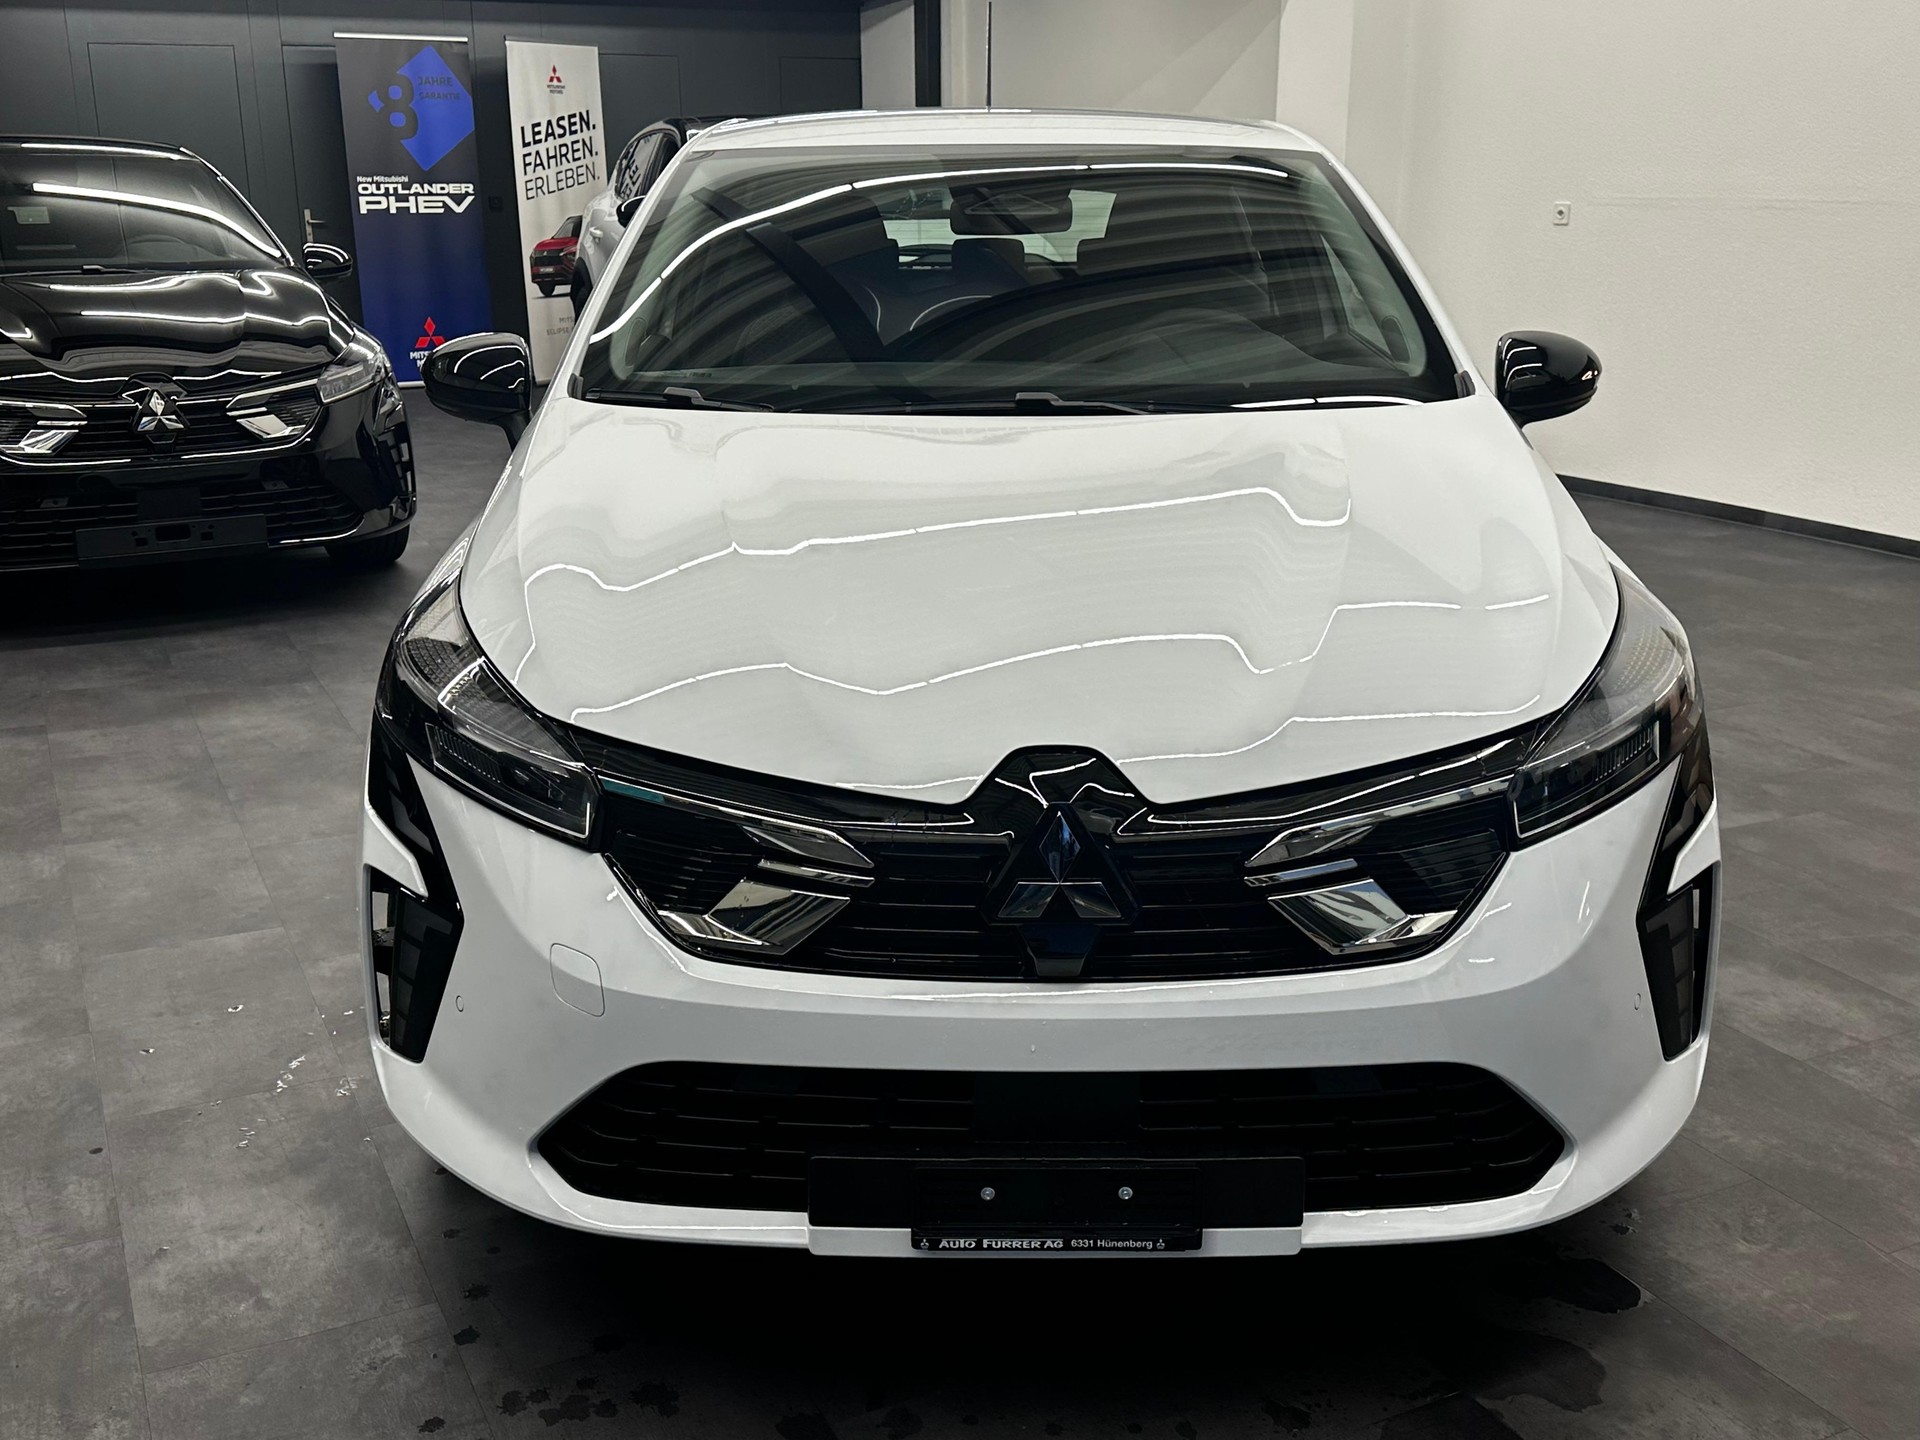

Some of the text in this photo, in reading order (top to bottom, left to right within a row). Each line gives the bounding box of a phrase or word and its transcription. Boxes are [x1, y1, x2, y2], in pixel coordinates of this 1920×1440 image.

[418, 76, 453, 86] JAHRE
[520, 109, 597, 149] LEASEN.
[522, 135, 599, 176] FAHREN.
[356, 175, 409, 183] New Mitsubishi
[524, 161, 601, 201] ERLEBEN.
[357, 183, 475, 195] OUTLANDER
[358, 195, 476, 214] PHEV
[939, 1238, 1153, 1250] AUTO FURRER AG 6331 Hünenberg
